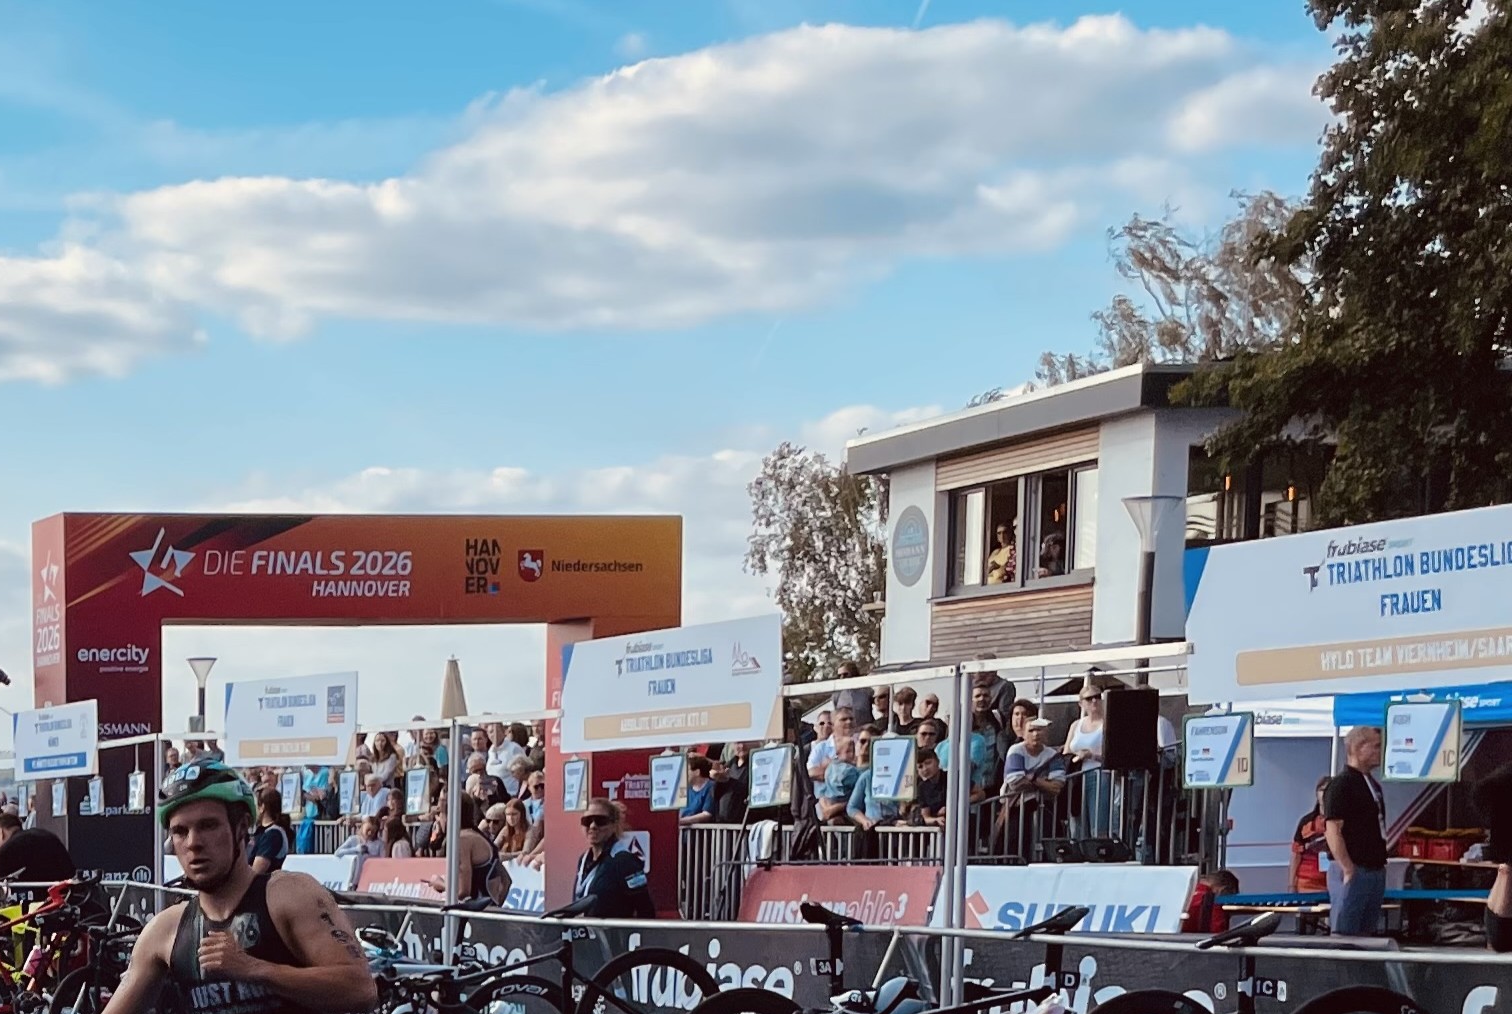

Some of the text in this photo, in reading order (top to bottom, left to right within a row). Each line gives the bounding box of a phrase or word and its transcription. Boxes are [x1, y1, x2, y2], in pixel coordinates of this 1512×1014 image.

[466, 539, 501, 556] HAN
[1327, 537, 1386, 558] frubiase
[204, 550, 413, 576] DIE FINALS 2026
[466, 557, 501, 575] NOV
[551, 559, 644, 573] Niedersachsen
[1327, 553, 1415, 586] TRIATHLON
[312, 580, 411, 597] HANNOVER
[465, 576, 488, 594] ER
[1380, 588, 1442, 617] FRAUEN
[36, 625, 60, 653] 2026
[77, 643, 150, 664] enercity
[1358, 646, 1393, 668] TEAM
[1395, 634, 1512, 665] VIERNHEIM/SAAR
[647, 679, 677, 696] FRAUEN
[1254, 712, 1283, 726] biase
[98, 723, 151, 735] SSMANN
[101, 804, 151, 817] parke
[83, 869, 129, 881] Aanz
[368, 876, 445, 900] unstopp
[993, 902, 1161, 933] SUUKI
[572, 927, 587, 938] 3C
[1064, 974, 1075, 987] D
[1255, 980, 1274, 995] 1C
[492, 983, 548, 999] roval
